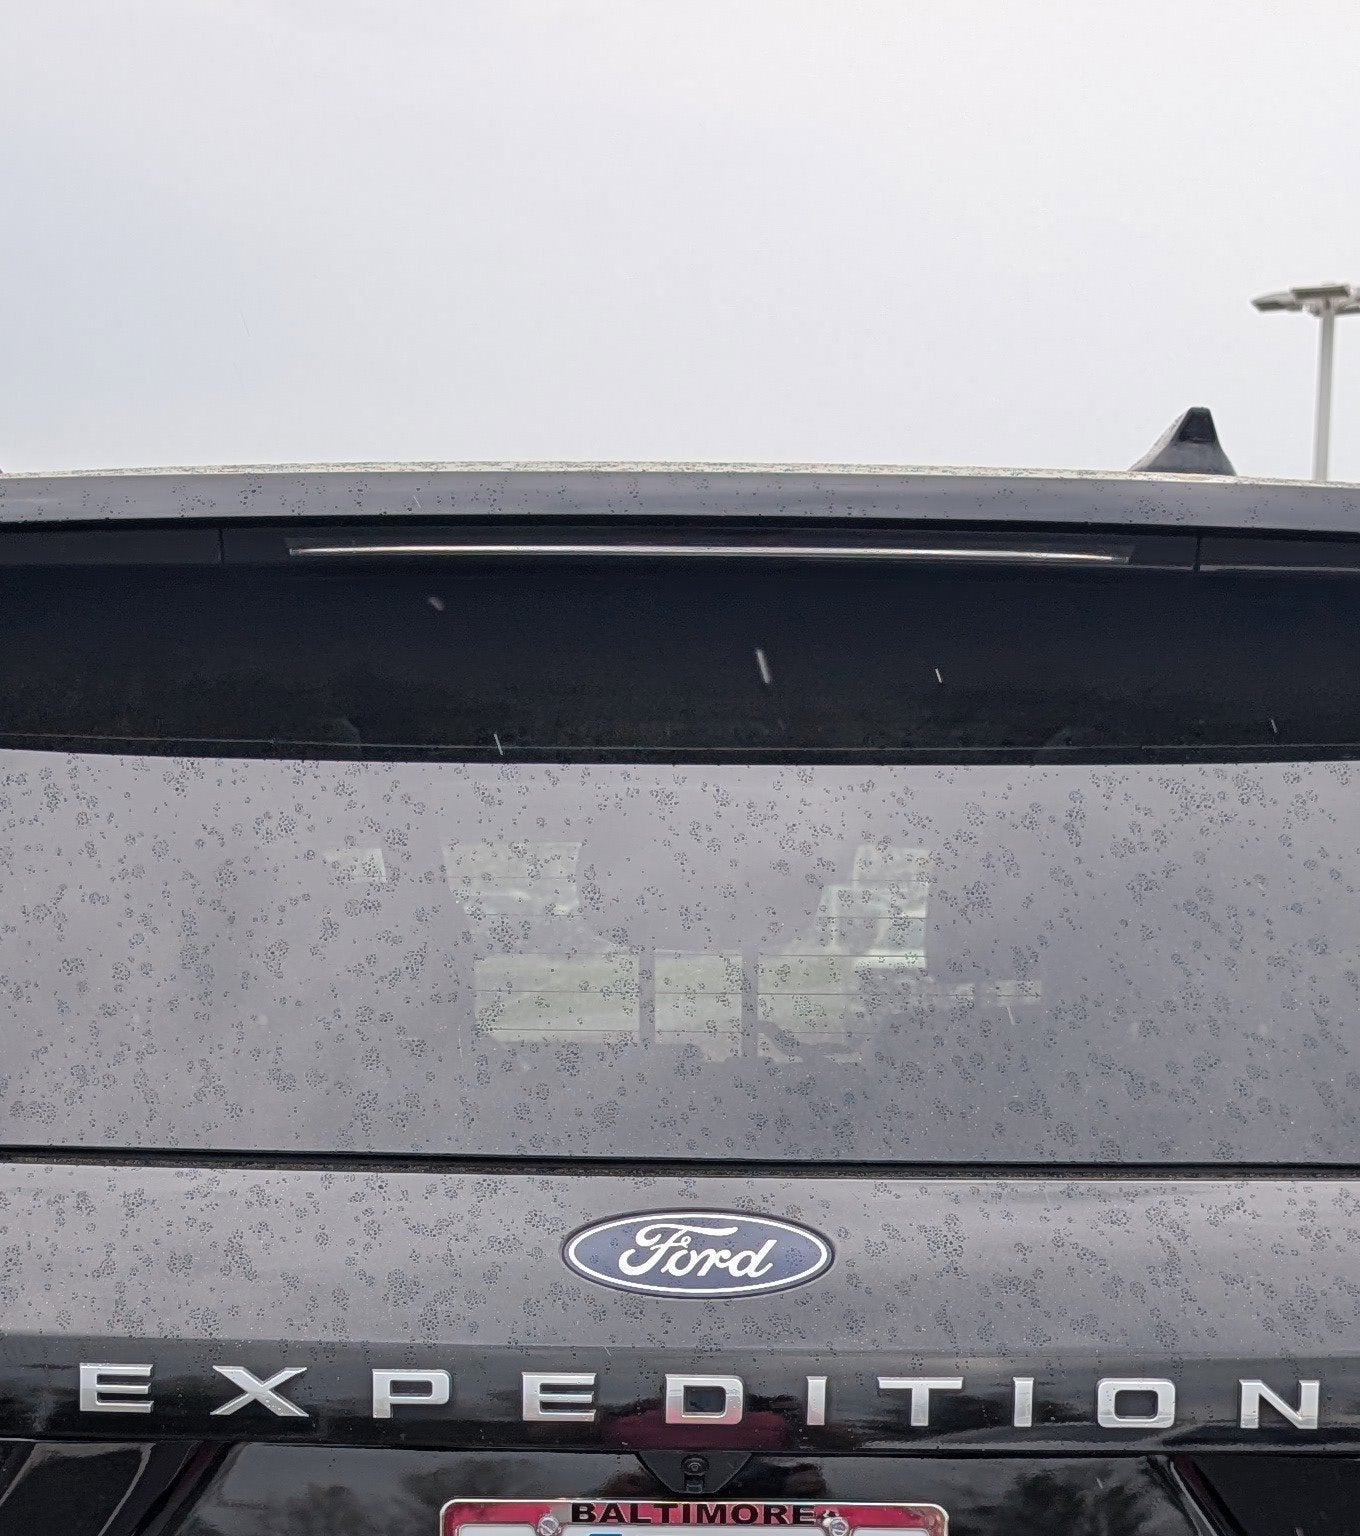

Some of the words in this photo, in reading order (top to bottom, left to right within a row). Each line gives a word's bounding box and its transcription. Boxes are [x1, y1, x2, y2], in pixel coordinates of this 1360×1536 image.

[618, 1222, 776, 1284] Ford
[78, 1361, 1321, 1431] EXPEDITION
[570, 1502, 817, 1525] BALTIMORE
